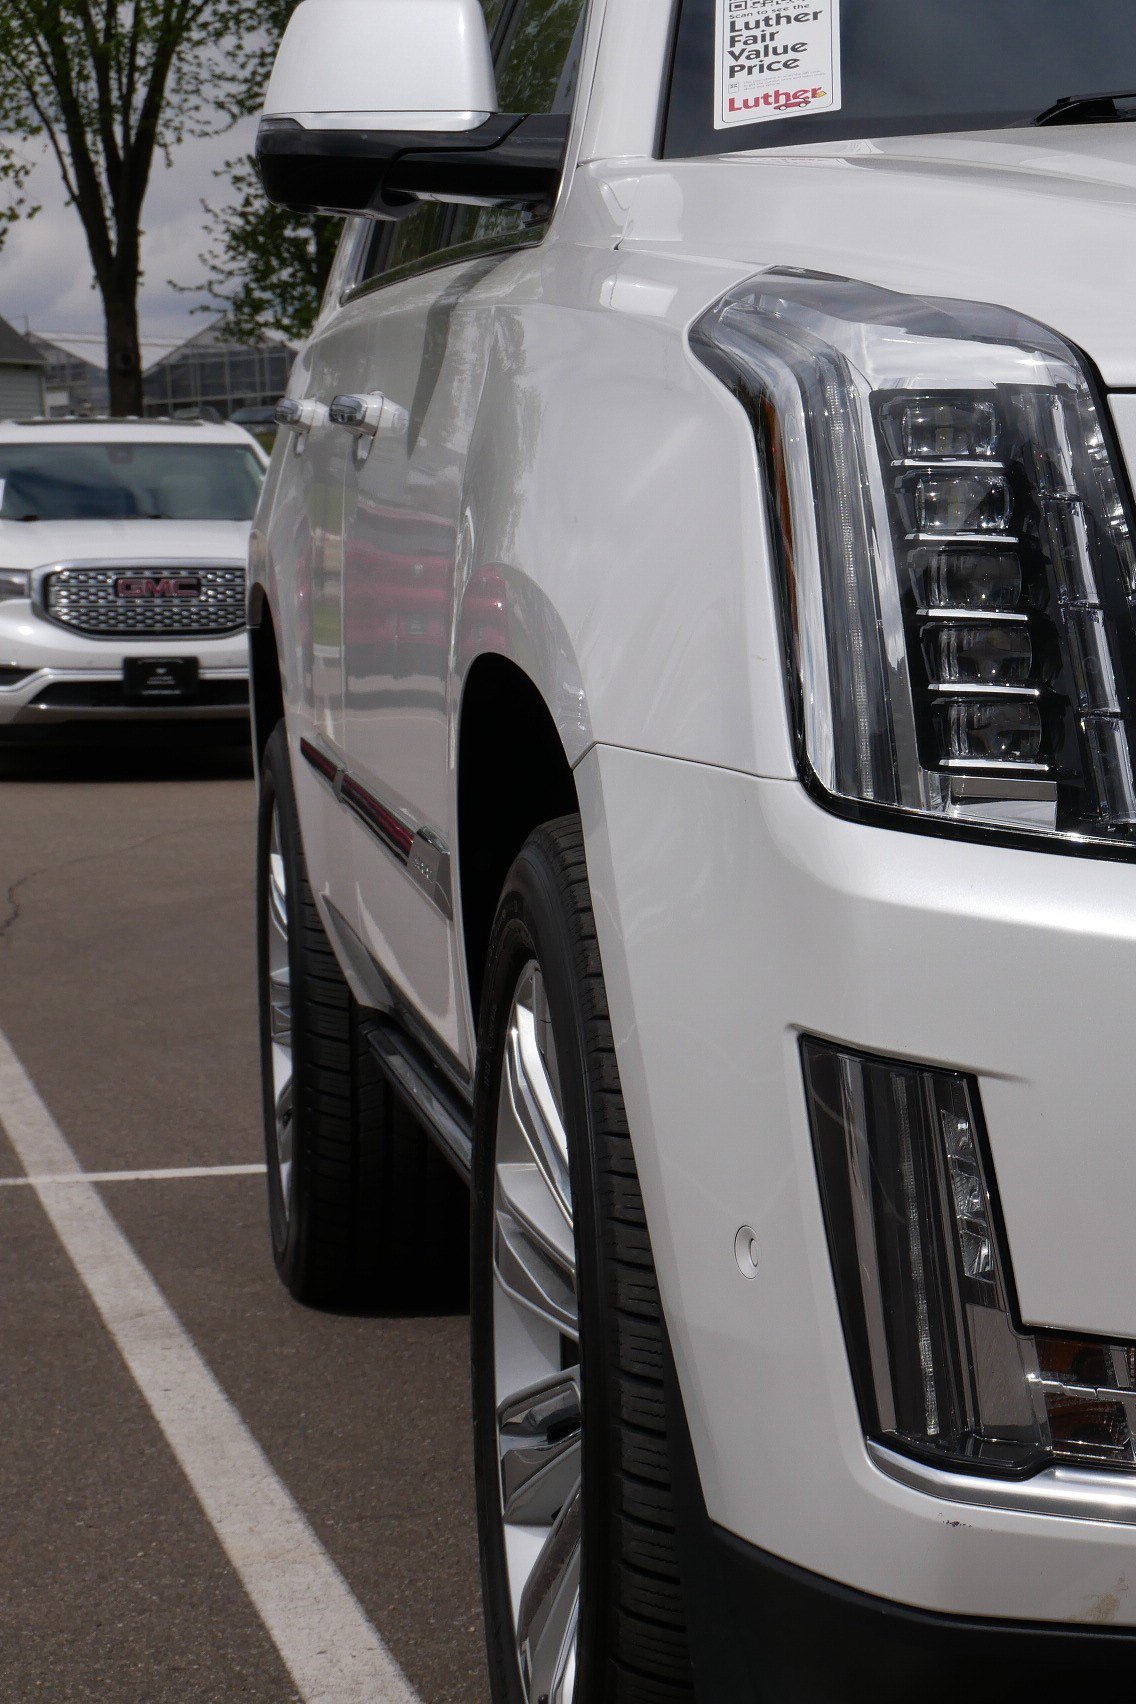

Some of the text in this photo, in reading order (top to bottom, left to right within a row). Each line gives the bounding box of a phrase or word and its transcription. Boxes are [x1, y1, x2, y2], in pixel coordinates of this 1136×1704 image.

[729, 10, 823, 33] Luther
[729, 29, 780, 49] Fair
[727, 42, 808, 62] Value
[728, 58, 800, 79] Price
[728, 86, 822, 112] Luther
[116, 577, 199, 598] GMC
